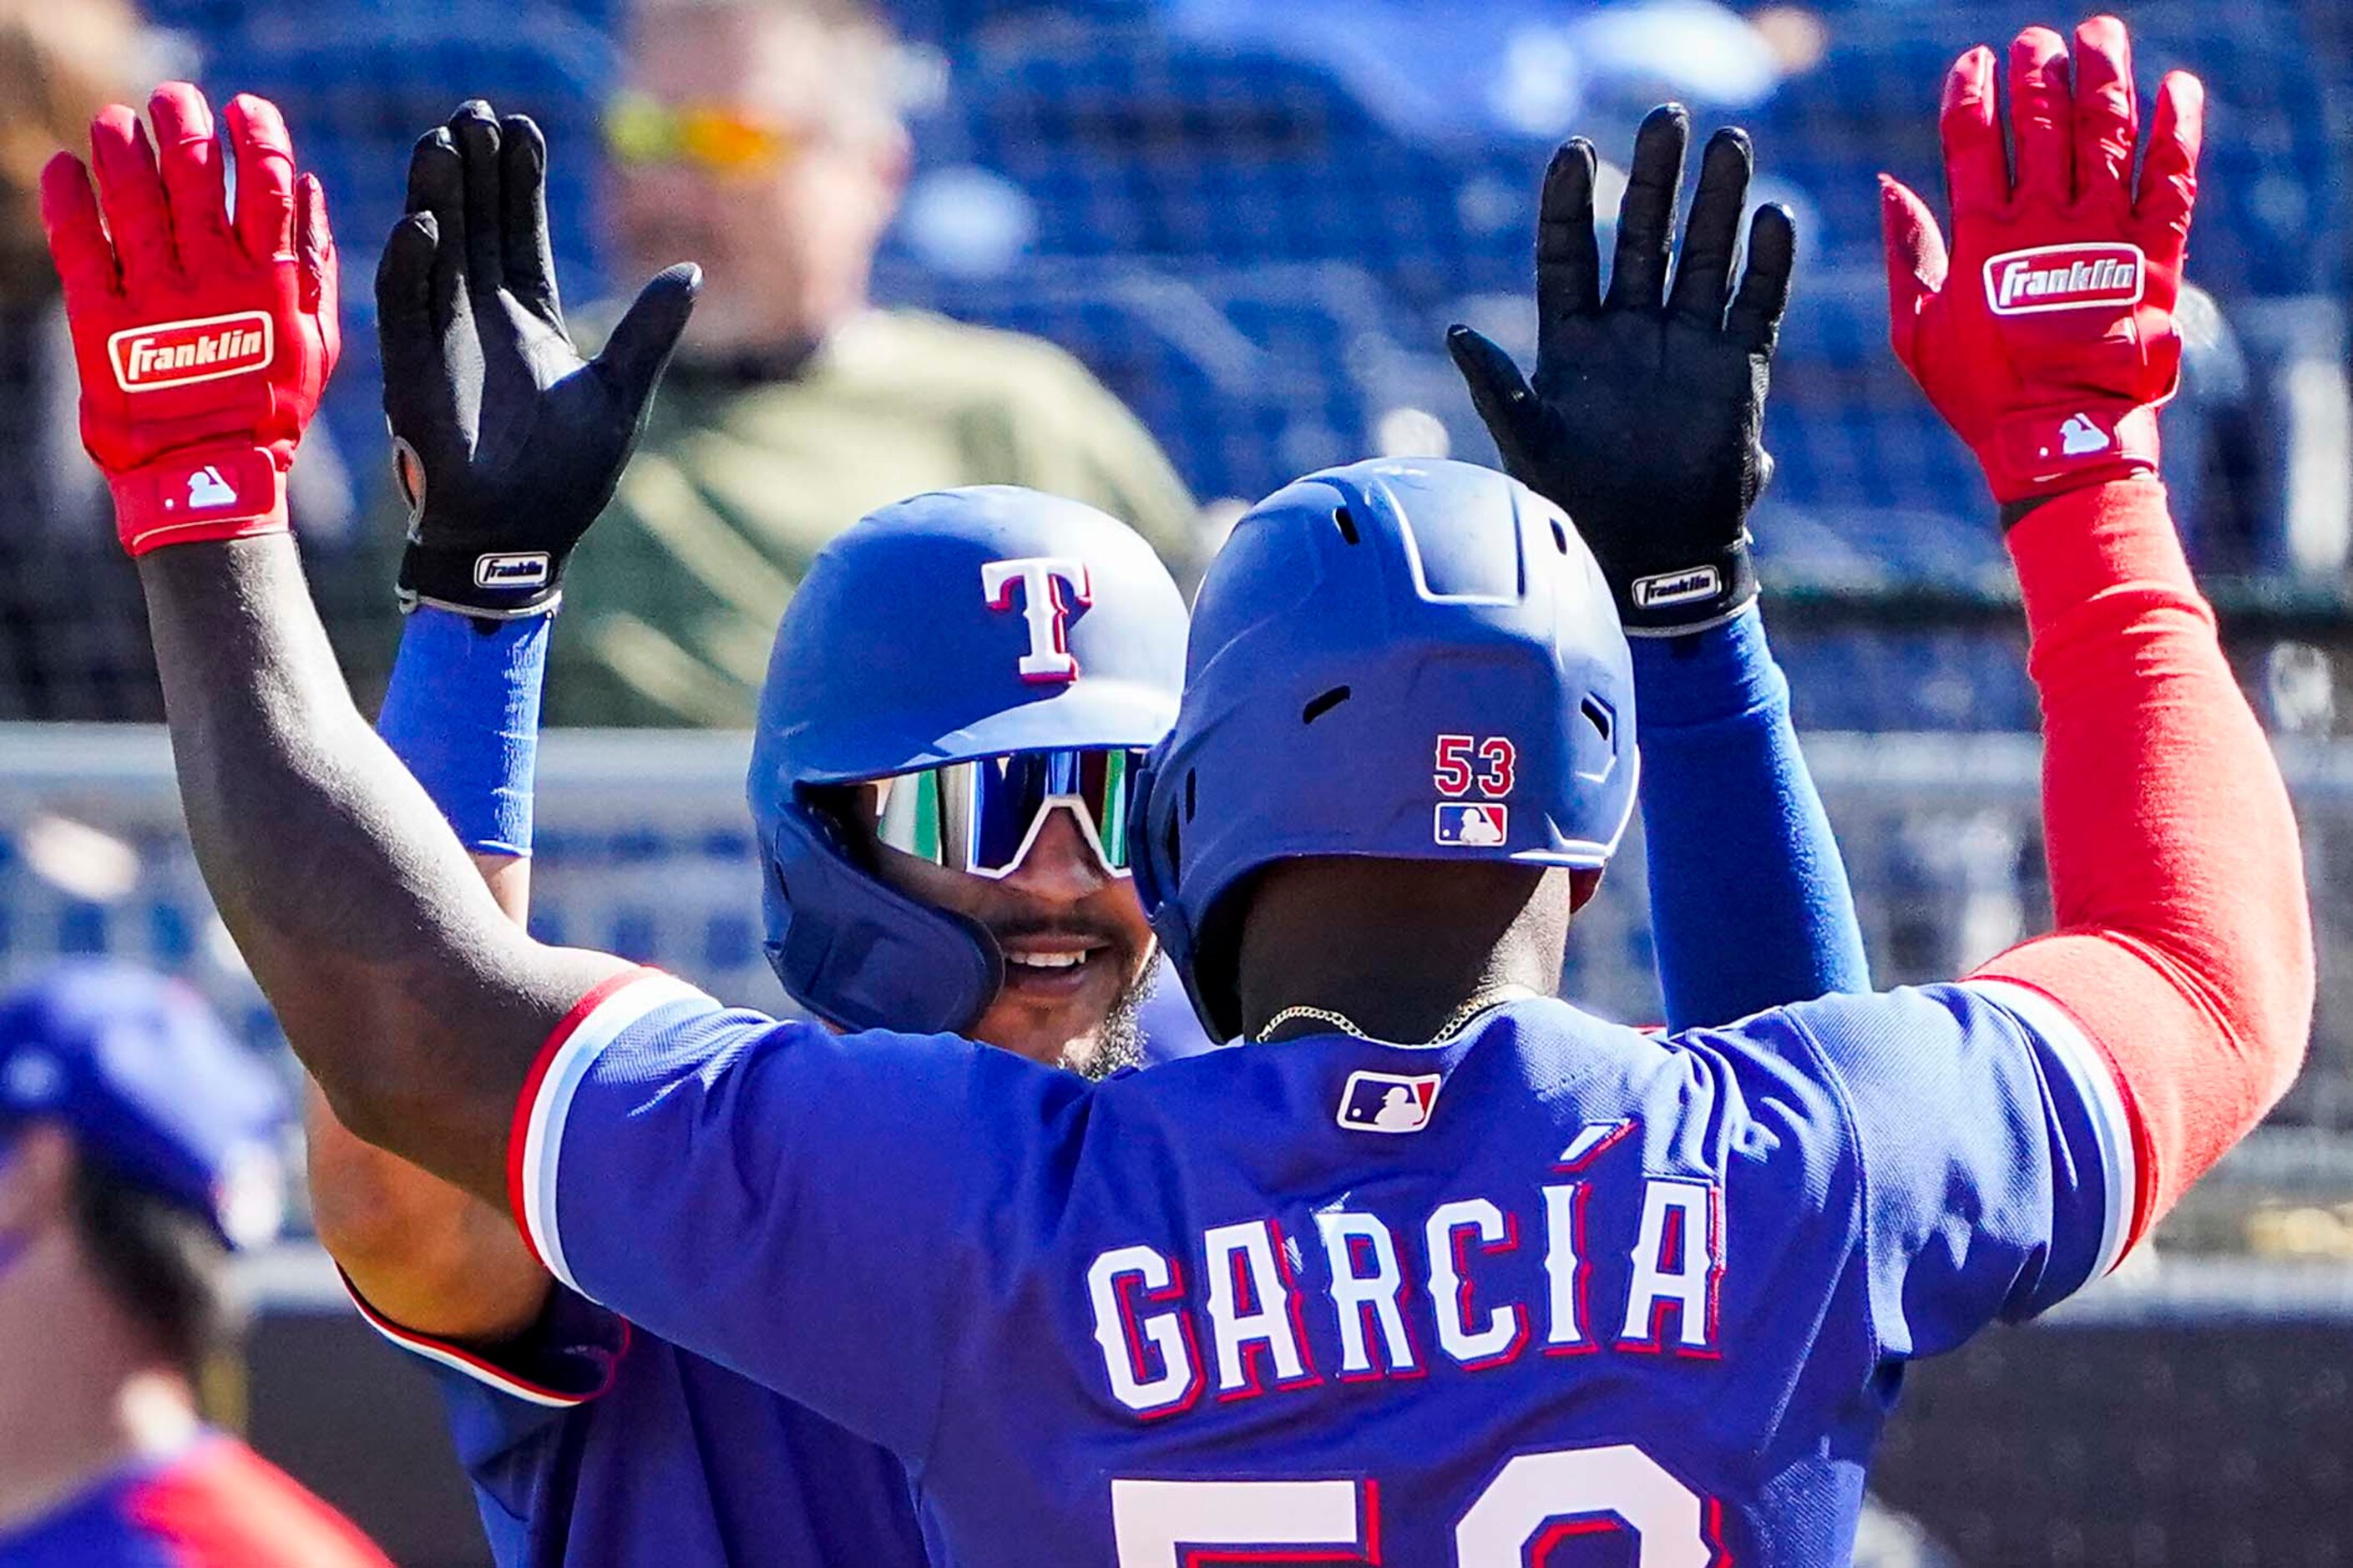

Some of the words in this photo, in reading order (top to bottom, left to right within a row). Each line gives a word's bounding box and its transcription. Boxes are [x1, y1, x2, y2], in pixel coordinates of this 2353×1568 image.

[1999, 259, 2135, 306] Franklin
[127, 329, 262, 381] Franklin
[981, 558, 1090, 682] T
[1433, 734, 1516, 798] 53
[1086, 1120, 1725, 1421] GARCÍA
